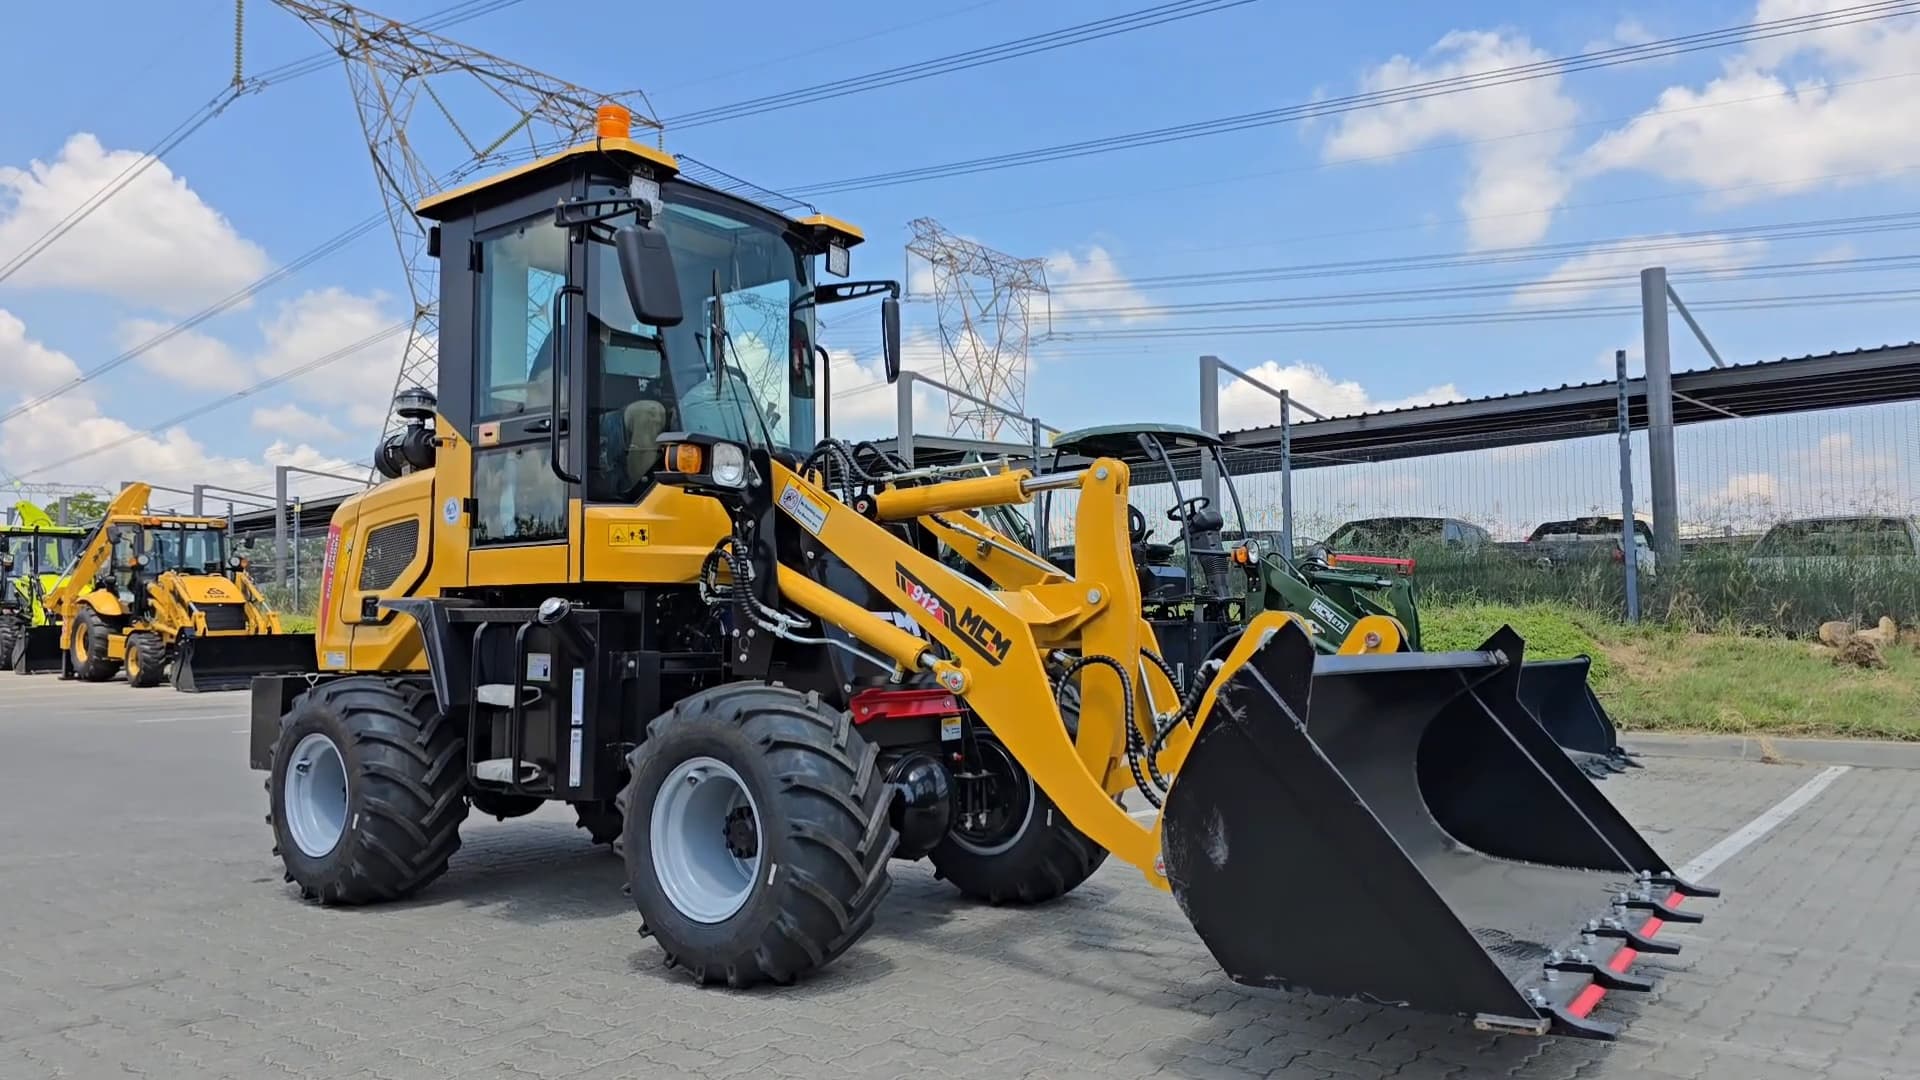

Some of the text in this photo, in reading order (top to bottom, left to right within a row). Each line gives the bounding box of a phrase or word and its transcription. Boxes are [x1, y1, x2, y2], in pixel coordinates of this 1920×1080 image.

[911, 585, 940, 615] 912
[1311, 601, 1335, 622] MCM
[959, 606, 1012, 661] MCM
